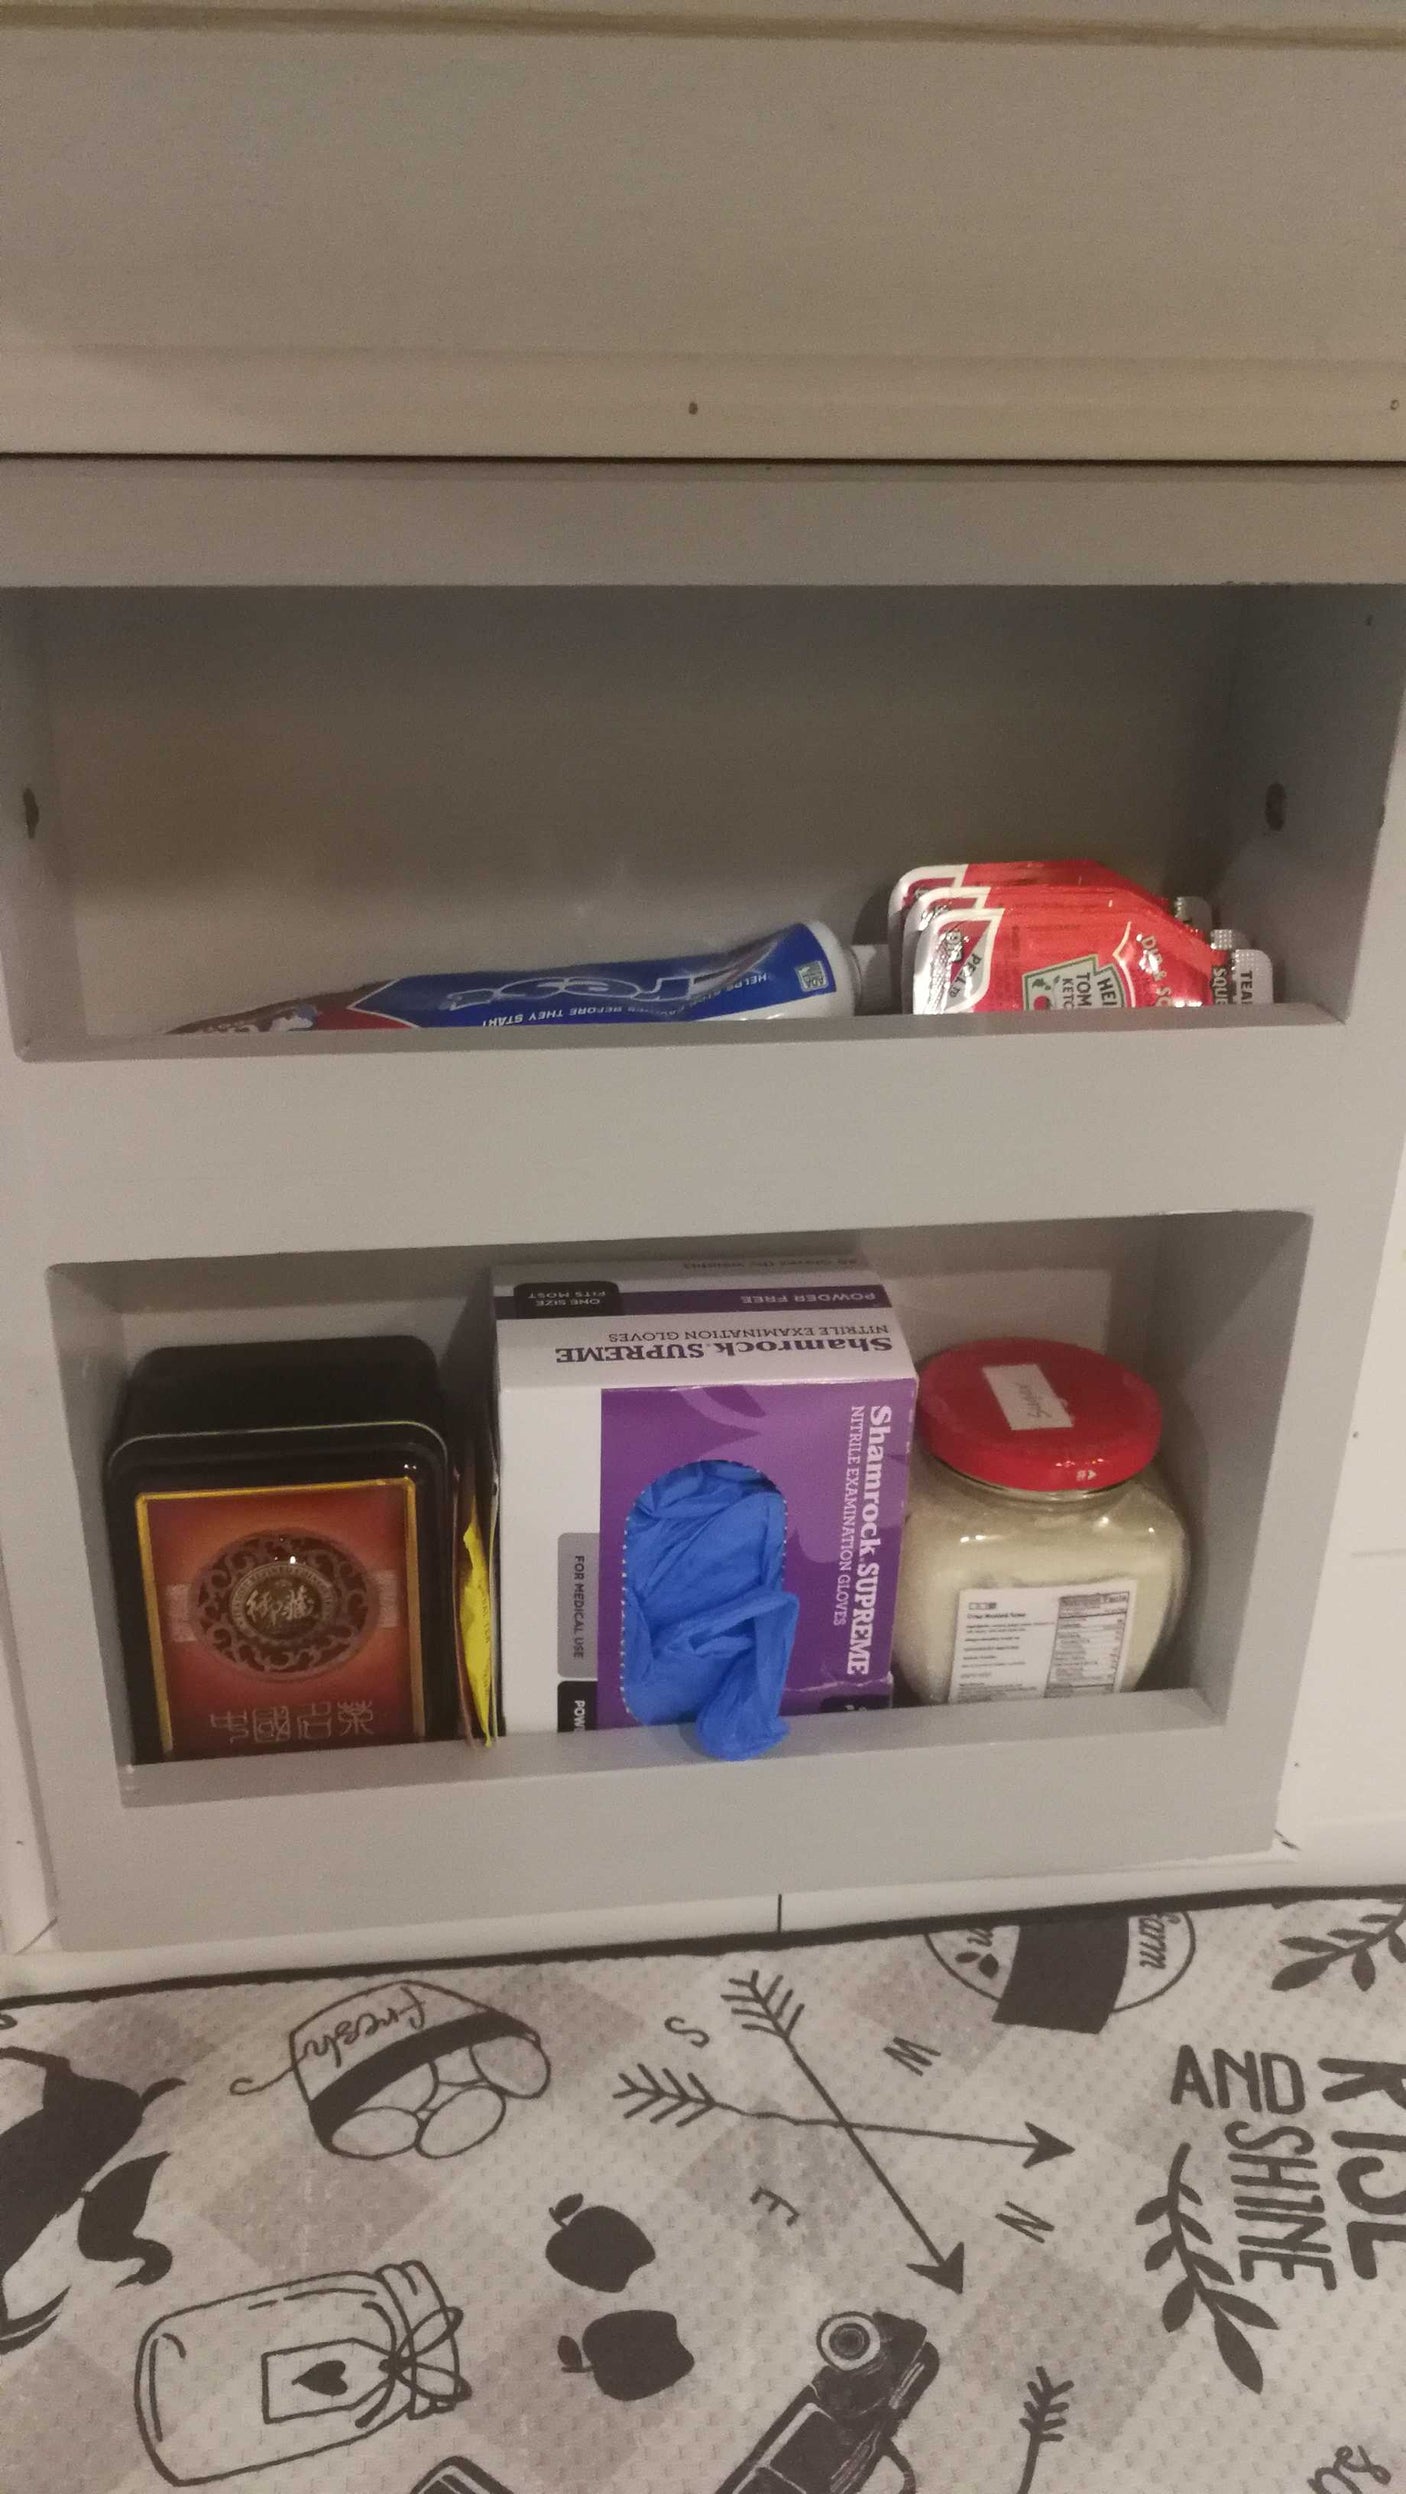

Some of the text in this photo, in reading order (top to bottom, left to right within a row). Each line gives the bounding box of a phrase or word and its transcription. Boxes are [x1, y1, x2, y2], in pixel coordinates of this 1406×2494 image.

[1062, 977, 1074, 1008] KETC
[1076, 972, 1091, 1008] TOM
[1096, 977, 1118, 1007] HEI
[1212, 967, 1228, 1005] SQUE
[528, 1008, 564, 1021] THEY
[568, 1005, 623, 1017] BEFORE
[528, 1290, 606, 1300] FITS MOST
[535, 1297, 601, 1308] ONE SIZE
[740, 1291, 877, 1305] POWDER FREE
[608, 1324, 889, 1342] NITRILE EXAMINATION GLOVES
[555, 1336, 893, 1364] Shamrock SUPREME
[859, 1404, 892, 1561] Shamrock
[833, 1405, 865, 1627] NITRILE EXAMINATION GLOVES
[573, 1555, 585, 1659] FOR MEDICAL USE
[847, 1562, 881, 1676] SUPREME
[302, 1986, 427, 2068] Fresh
[664, 2015, 710, 2048] S
[1170, 2044, 1306, 2116] AND
[1223, 2119, 1337, 2291] SHINE
